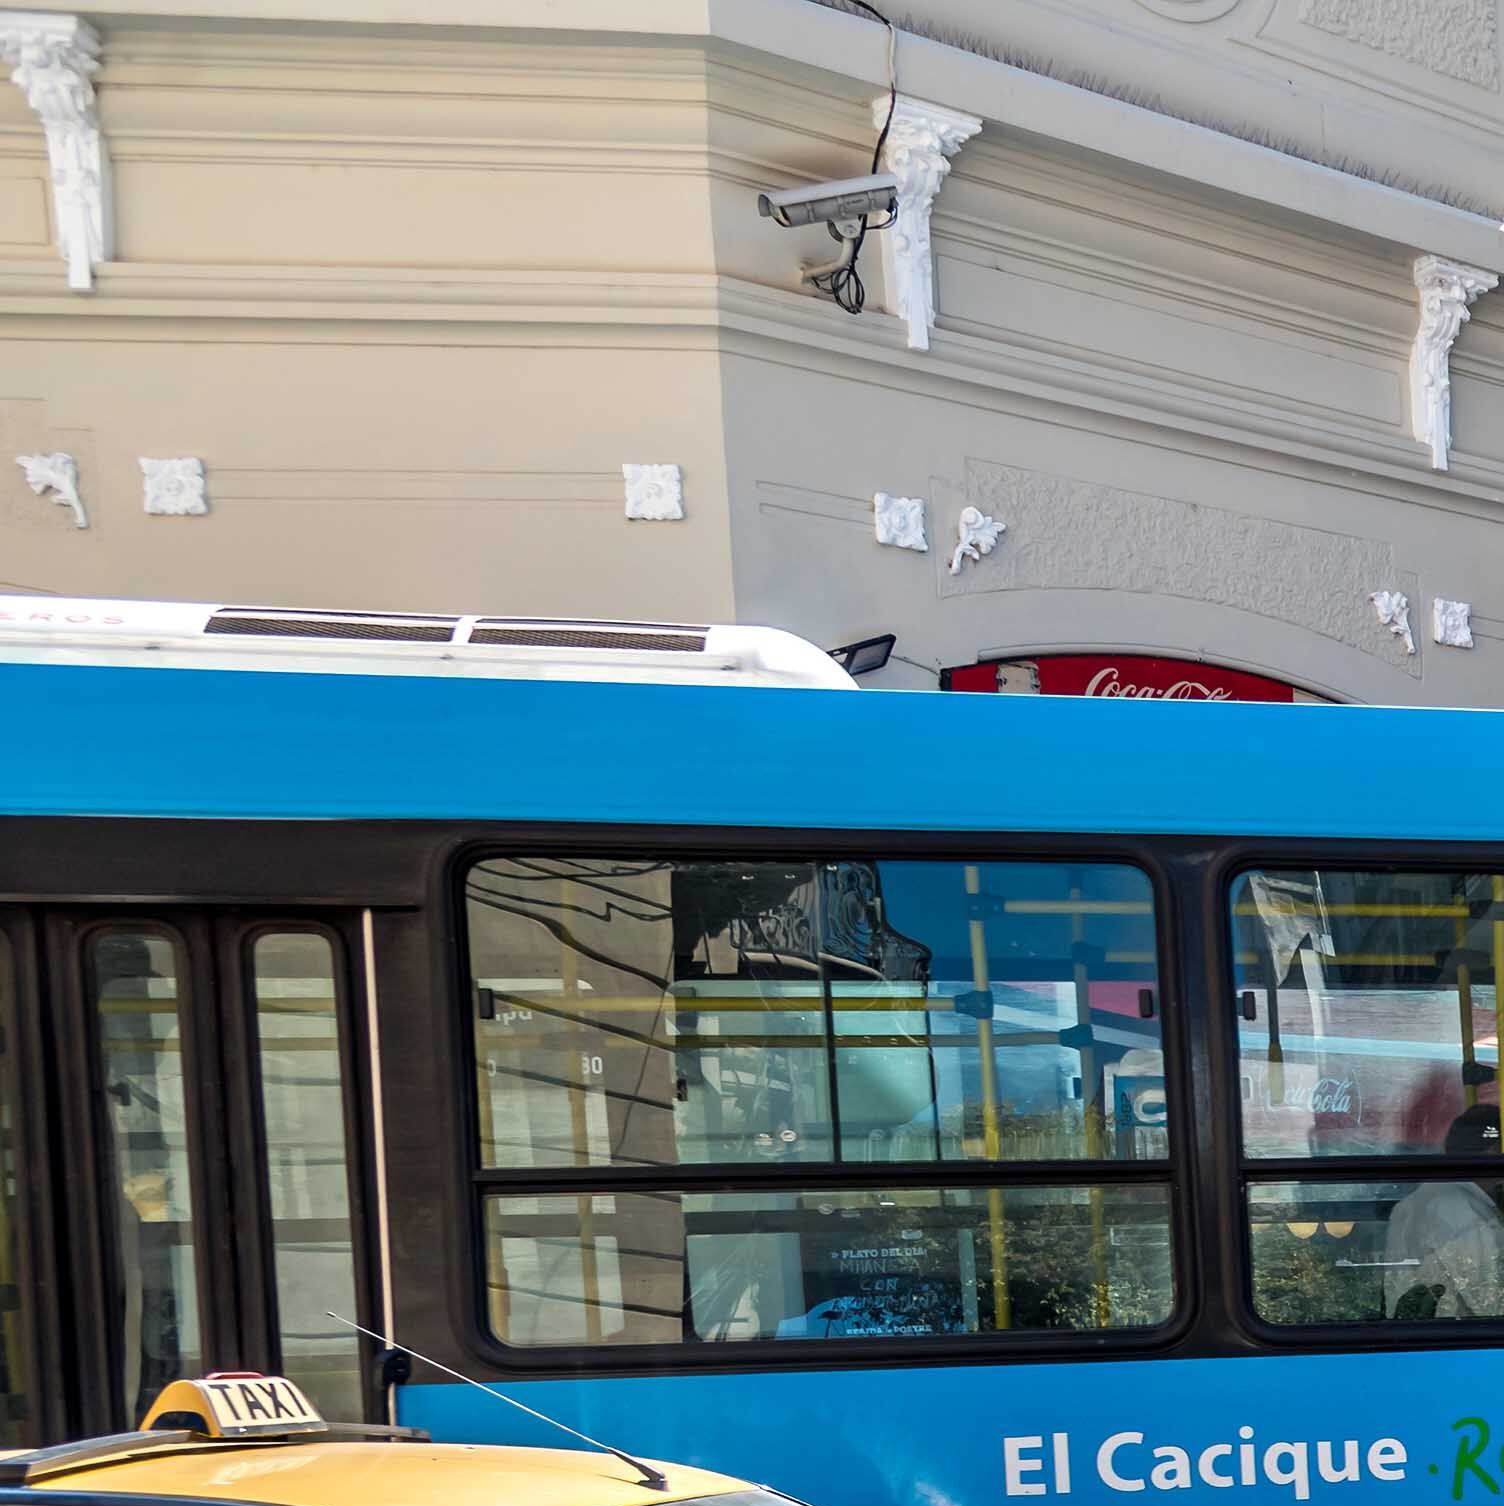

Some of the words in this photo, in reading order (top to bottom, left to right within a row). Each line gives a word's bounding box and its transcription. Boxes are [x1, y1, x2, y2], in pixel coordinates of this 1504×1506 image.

[208, 1382, 308, 1421] TAXI
[1003, 1431, 1071, 1497] El
[1096, 1425, 1409, 1500] Cacique
